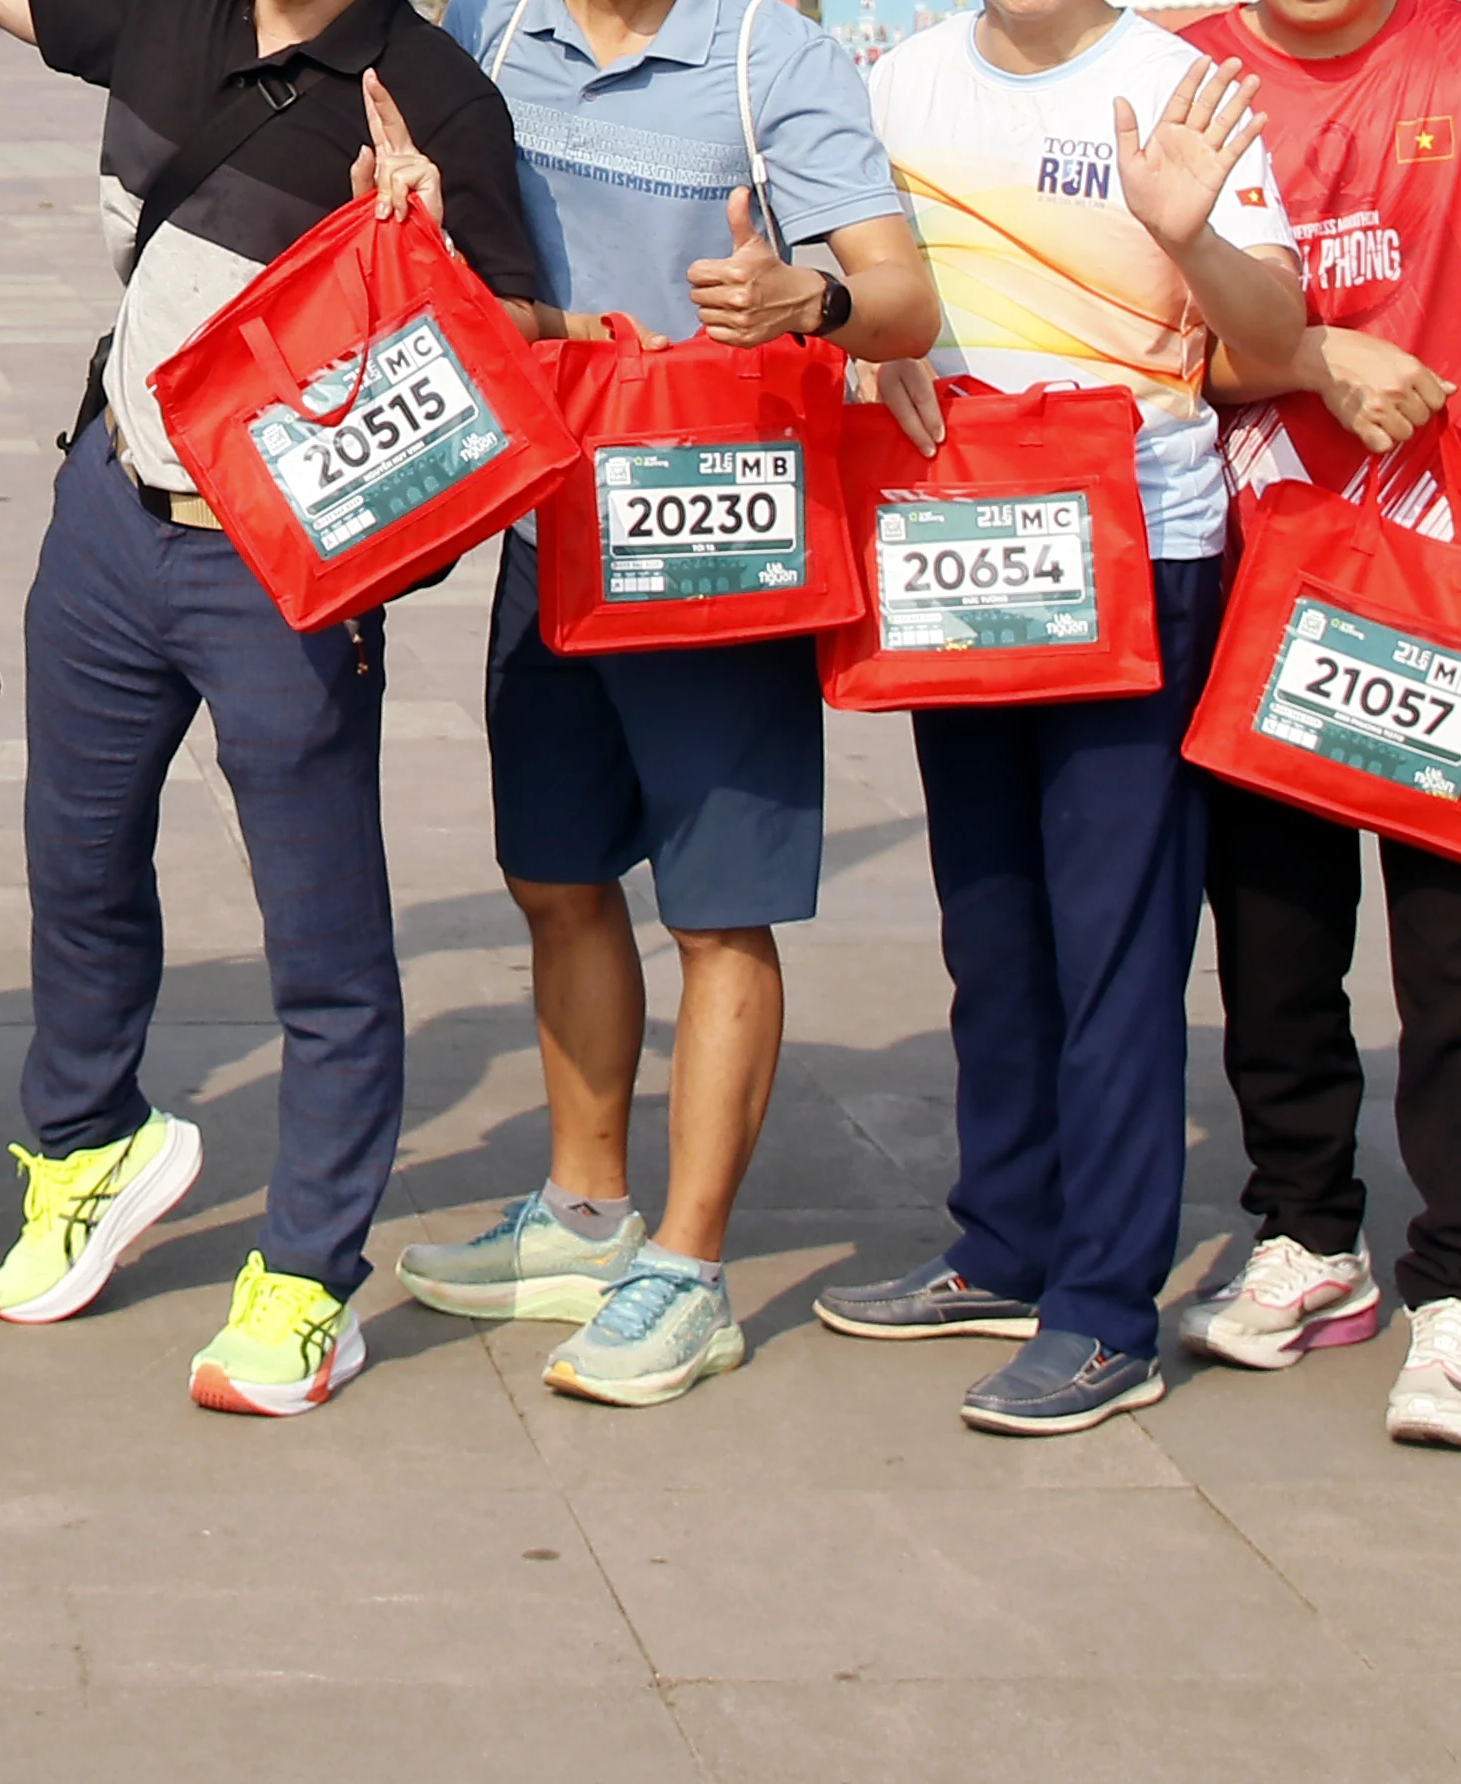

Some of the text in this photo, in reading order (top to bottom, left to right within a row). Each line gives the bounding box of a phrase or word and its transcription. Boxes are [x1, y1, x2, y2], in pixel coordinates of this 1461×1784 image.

[1044, 137, 1113, 160] TOTO
[1037, 156, 1111, 200] RUN
[385, 349, 411, 375] M
[413, 335, 432, 356] C
[303, 377, 446, 490] 20515
[742, 458, 761, 478] M
[774, 456, 788, 476] B
[627, 492, 776, 538] 20230
[1021, 509, 1043, 529] M
[1053, 508, 1072, 528] C
[903, 544, 1064, 592] 20654
[1434, 663, 1457, 686] M
[1305, 656, 1454, 736] 21057
